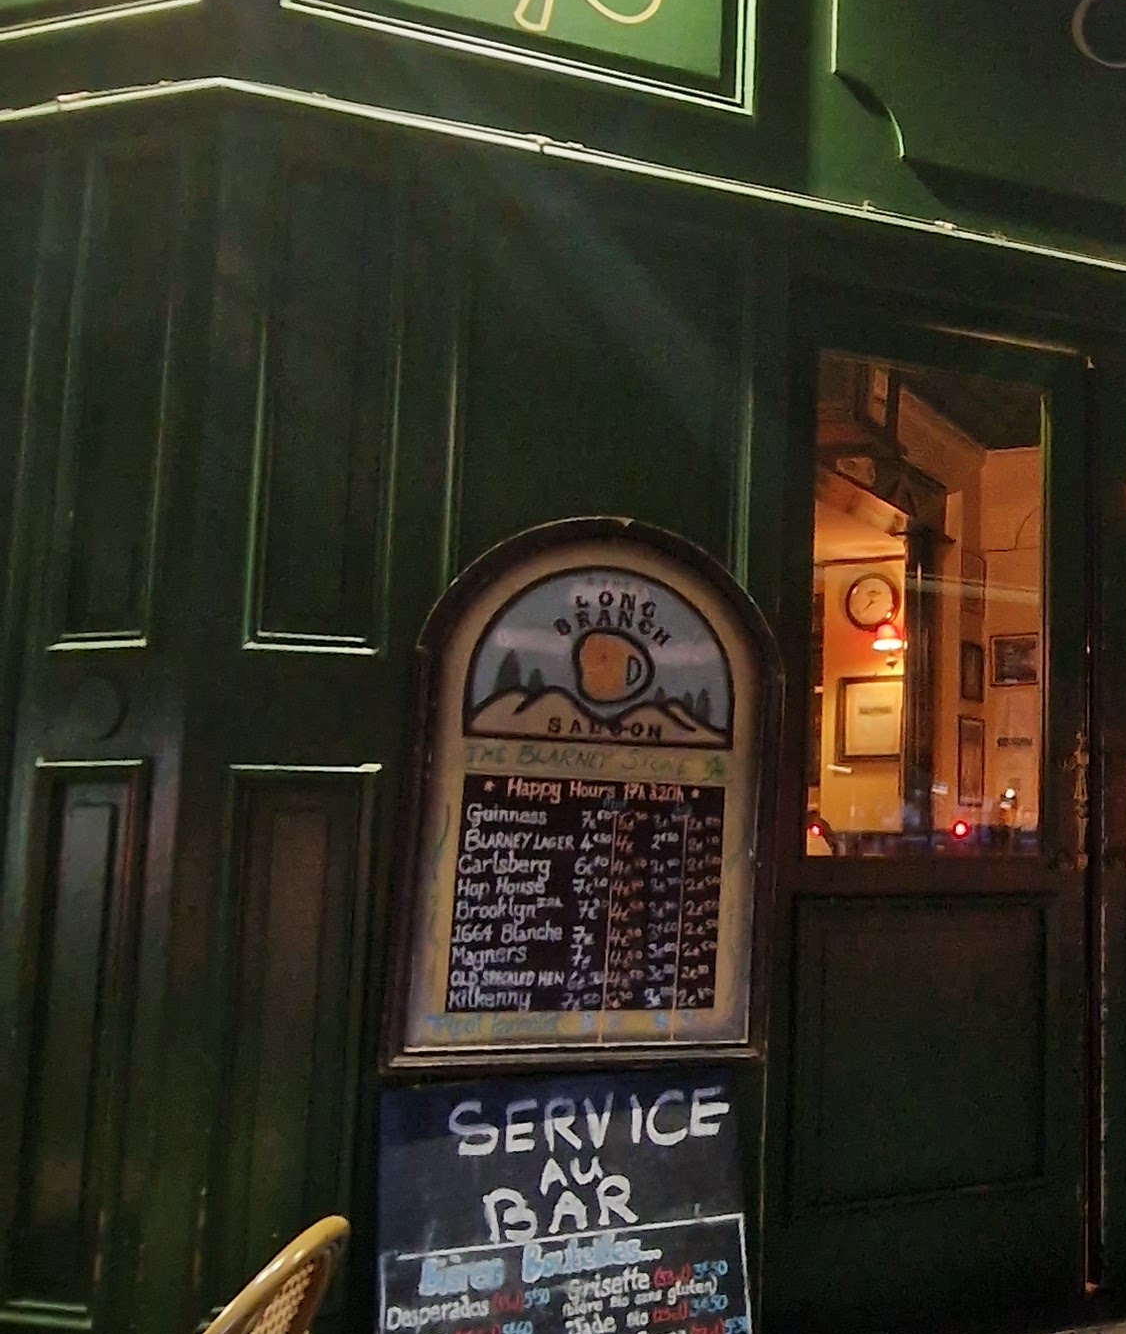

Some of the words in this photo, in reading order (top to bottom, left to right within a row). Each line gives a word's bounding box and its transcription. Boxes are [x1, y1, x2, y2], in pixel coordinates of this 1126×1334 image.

[575, 590, 656, 620] LONG
[554, 609, 672, 648] BRANCH
[548, 716, 662, 739] SALOON
[507, 777, 562, 805] Happy
[569, 779, 616, 799] Hours
[466, 803, 548, 827] Guinness
[464, 829, 532, 852] BLARNEY
[533, 833, 575, 851] LAGER
[458, 850, 552, 881] Carlsberg
[457, 878, 490, 901] Hop
[496, 876, 547, 896] House
[455, 895, 536, 925] Brooklyn
[452, 923, 495, 944] 1664
[501, 919, 563, 946] Blanche
[451, 945, 528, 973] Magners
[450, 970, 479, 988] OLD
[449, 1087, 730, 1156] SERVICE
[483, 1174, 639, 1244] BAR
[568, 1265, 652, 1305] Grisette
[386, 1294, 490, 1334] Desperados
